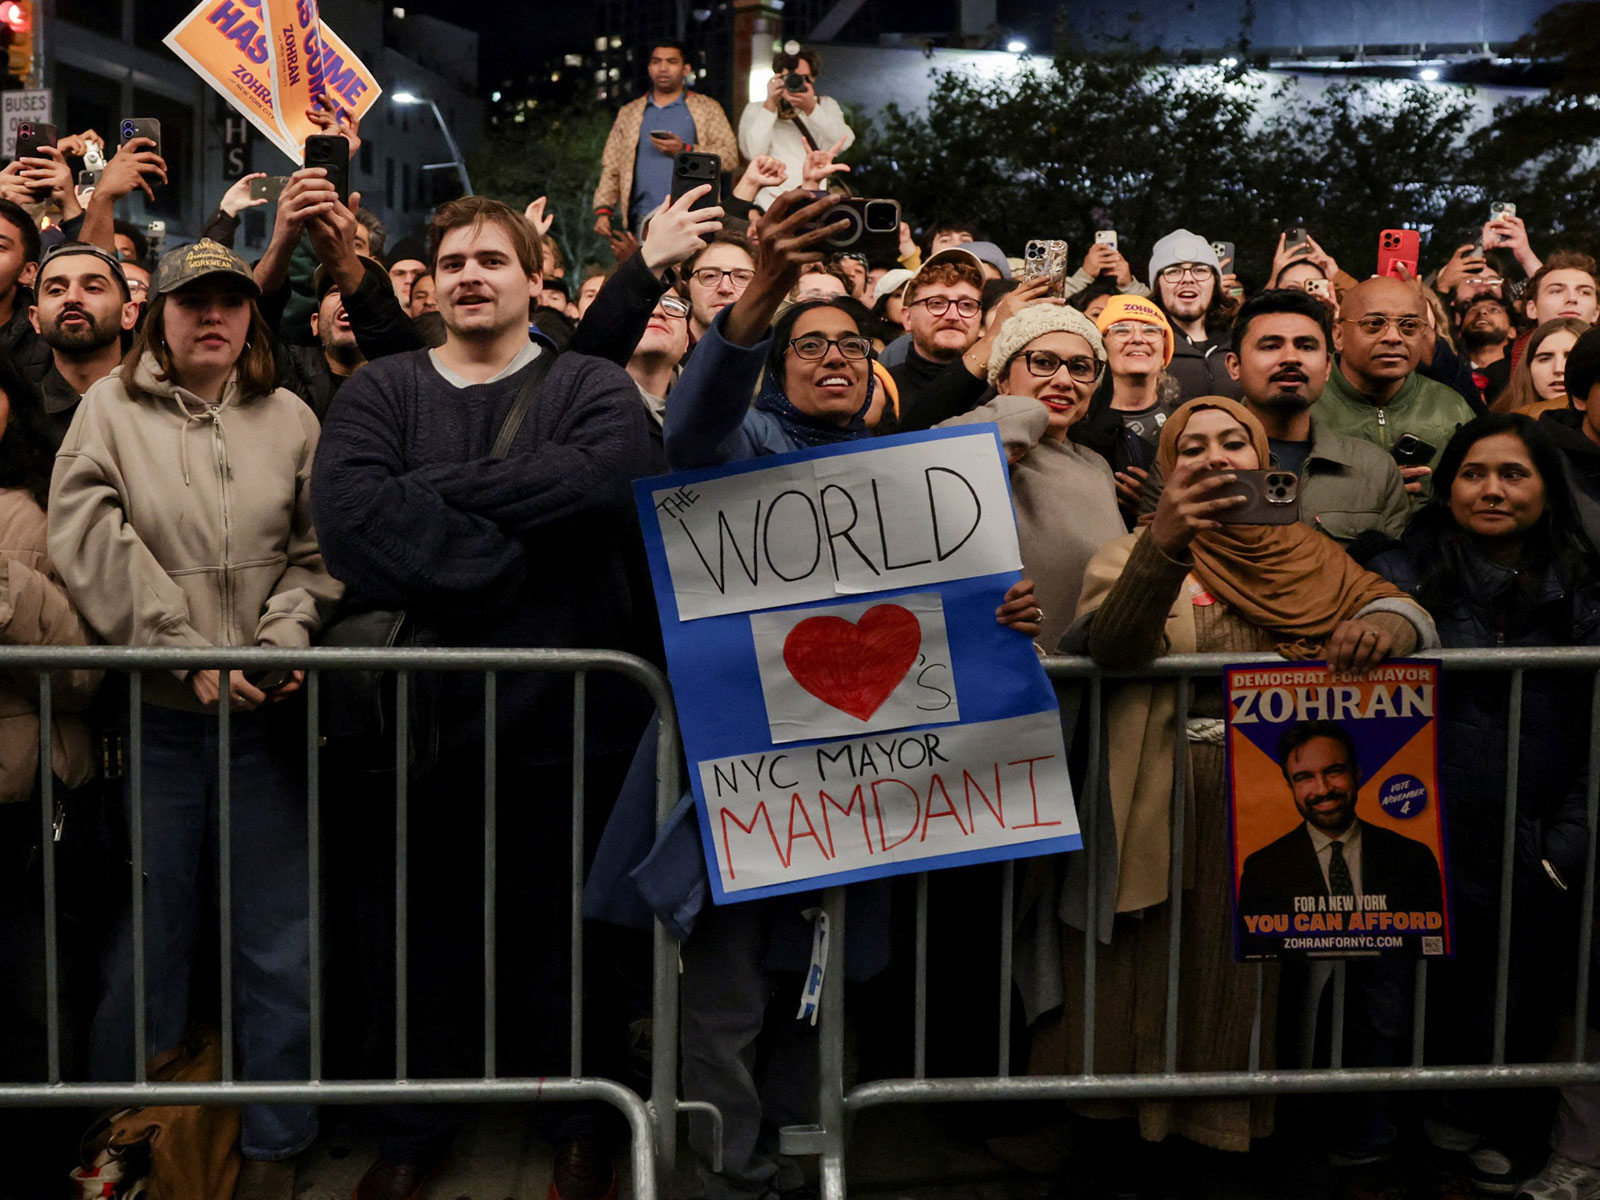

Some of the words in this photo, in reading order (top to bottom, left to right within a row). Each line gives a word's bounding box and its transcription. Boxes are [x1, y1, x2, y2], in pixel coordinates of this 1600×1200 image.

[206, 0, 269, 65] HAS
[283, 24, 300, 87] ZOHRAN
[232, 64, 273, 111] ZOHRA
[5, 96, 46, 112] BUSES
[235, 83, 249, 97] NEW
[249, 94, 262, 109] YORK
[262, 107, 275, 120] CITY
[189, 259, 232, 269] WORKWEAR
[1124, 303, 1164, 321] ZOHRAN
[655, 483, 700, 519] THE
[679, 466, 981, 594] WORLD
[1233, 671, 1326, 687] DEMOCRAT
[1368, 668, 1431, 682] MAYOR
[1230, 683, 1435, 724] ZOHRAN
[713, 755, 799, 797] NYC
[816, 733, 949, 781] MAYOR
[1381, 787, 1426, 806] NOVEMBER
[1390, 780, 1411, 793] VOTE
[720, 755, 1062, 880] MAMDANI
[1400, 800, 1411, 815] 4
[1294, 896, 1316, 912] FOR
[1318, 896, 1328, 911] A
[1329, 895, 1354, 911] NEW
[1355, 894, 1388, 911] YORK
[1244, 914, 1289, 933] YOU
[1294, 913, 1343, 932] CAN
[1348, 911, 1442, 931] AFFORD
[1284, 936, 1403, 949] ZOHRANFORNYC.COM
